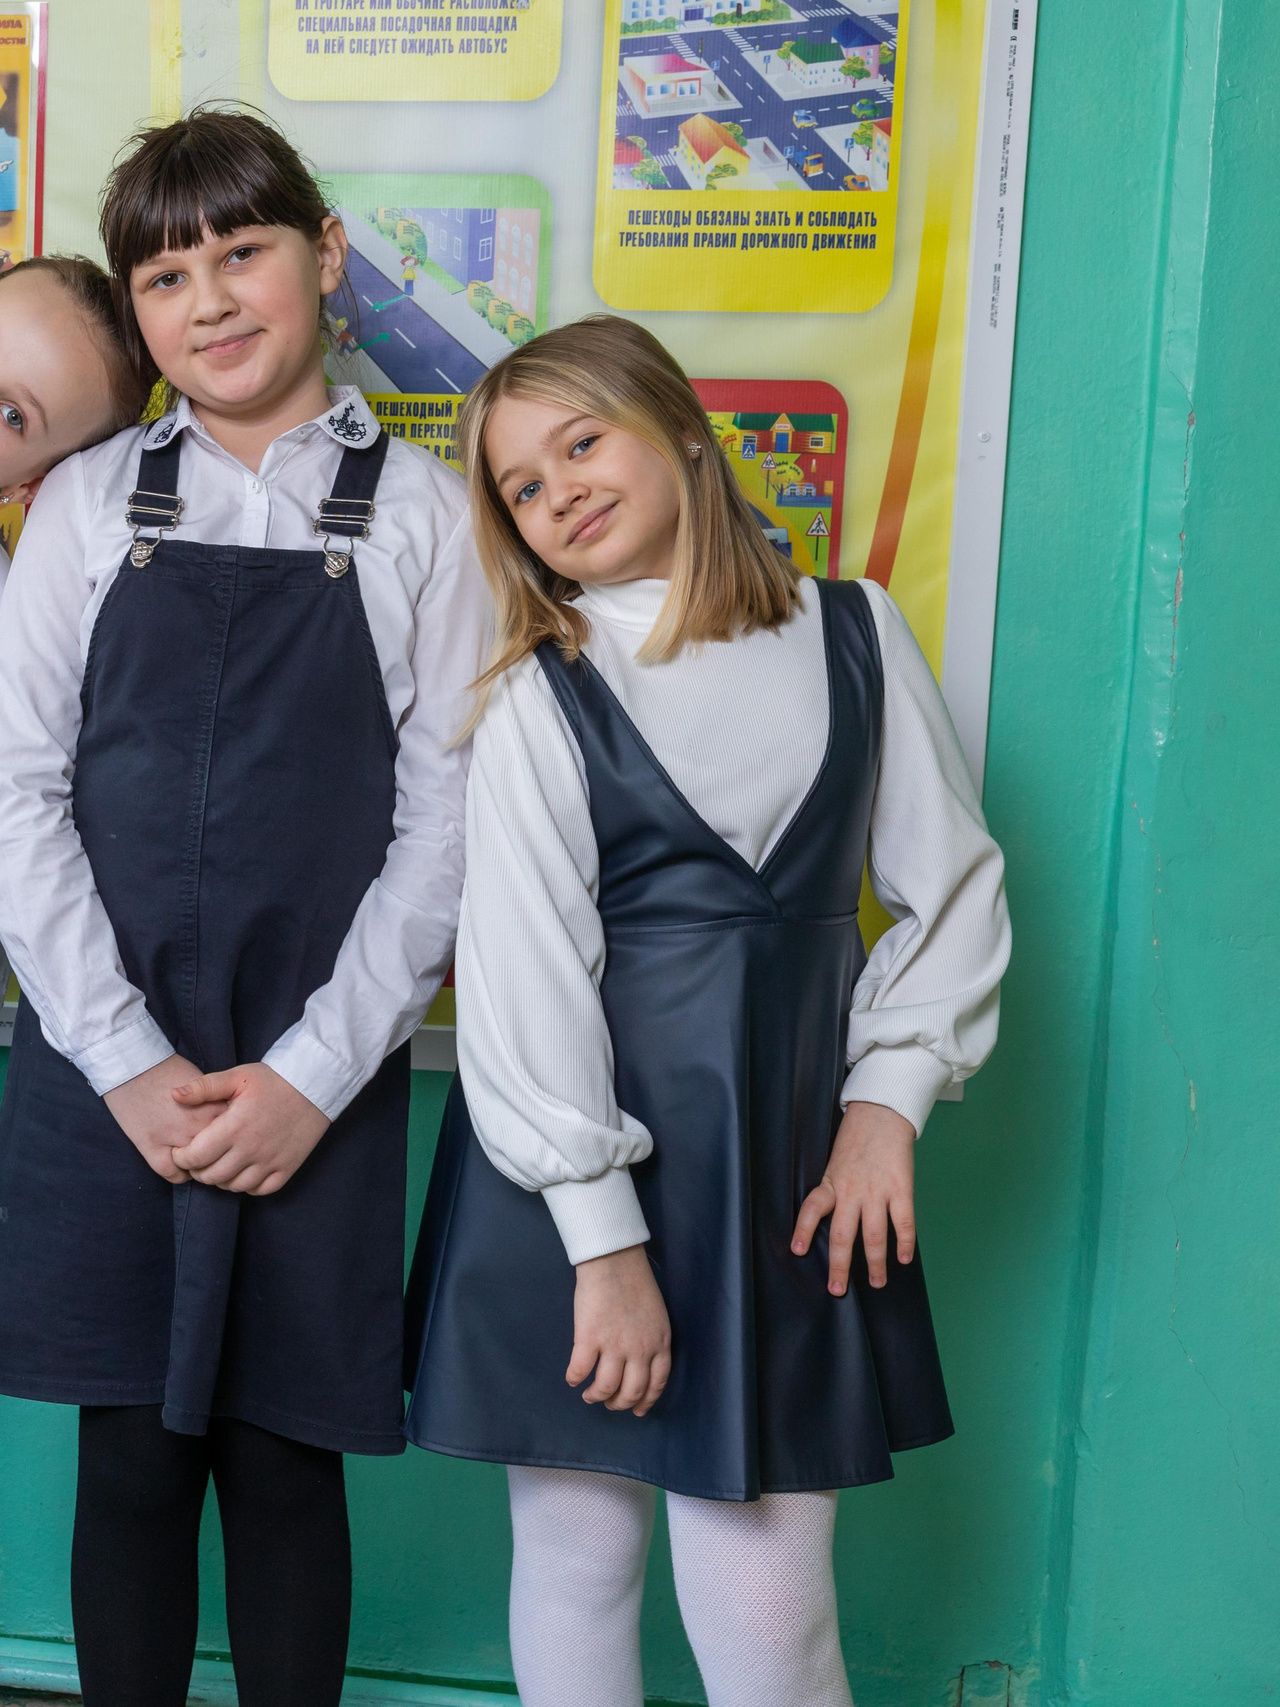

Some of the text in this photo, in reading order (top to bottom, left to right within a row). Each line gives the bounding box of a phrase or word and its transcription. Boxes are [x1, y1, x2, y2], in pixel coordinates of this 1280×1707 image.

[298, 16, 518, 34] СПЕЦИАЛЬНАЯ ПОСАДОЧНАЯ ПЛОЩАДКА
[306, 36, 507, 56] НА НЕЙ СЛЕДУЕТ ОЖИДАТЬ АВТОБУС
[628, 210, 877, 229] ПЕШЕХОДЫ ОБЯЗАНЫ ЗНАТЬ И СОБЛЮДАТЬ
[619, 231, 877, 251] ТРЕБОВАНИЯ ПРАВИЛ ДОРОЖНОГО ДВИЖЕНИЯ
[376, 400, 452, 419] ПЕШЕХОДНЫЙ
